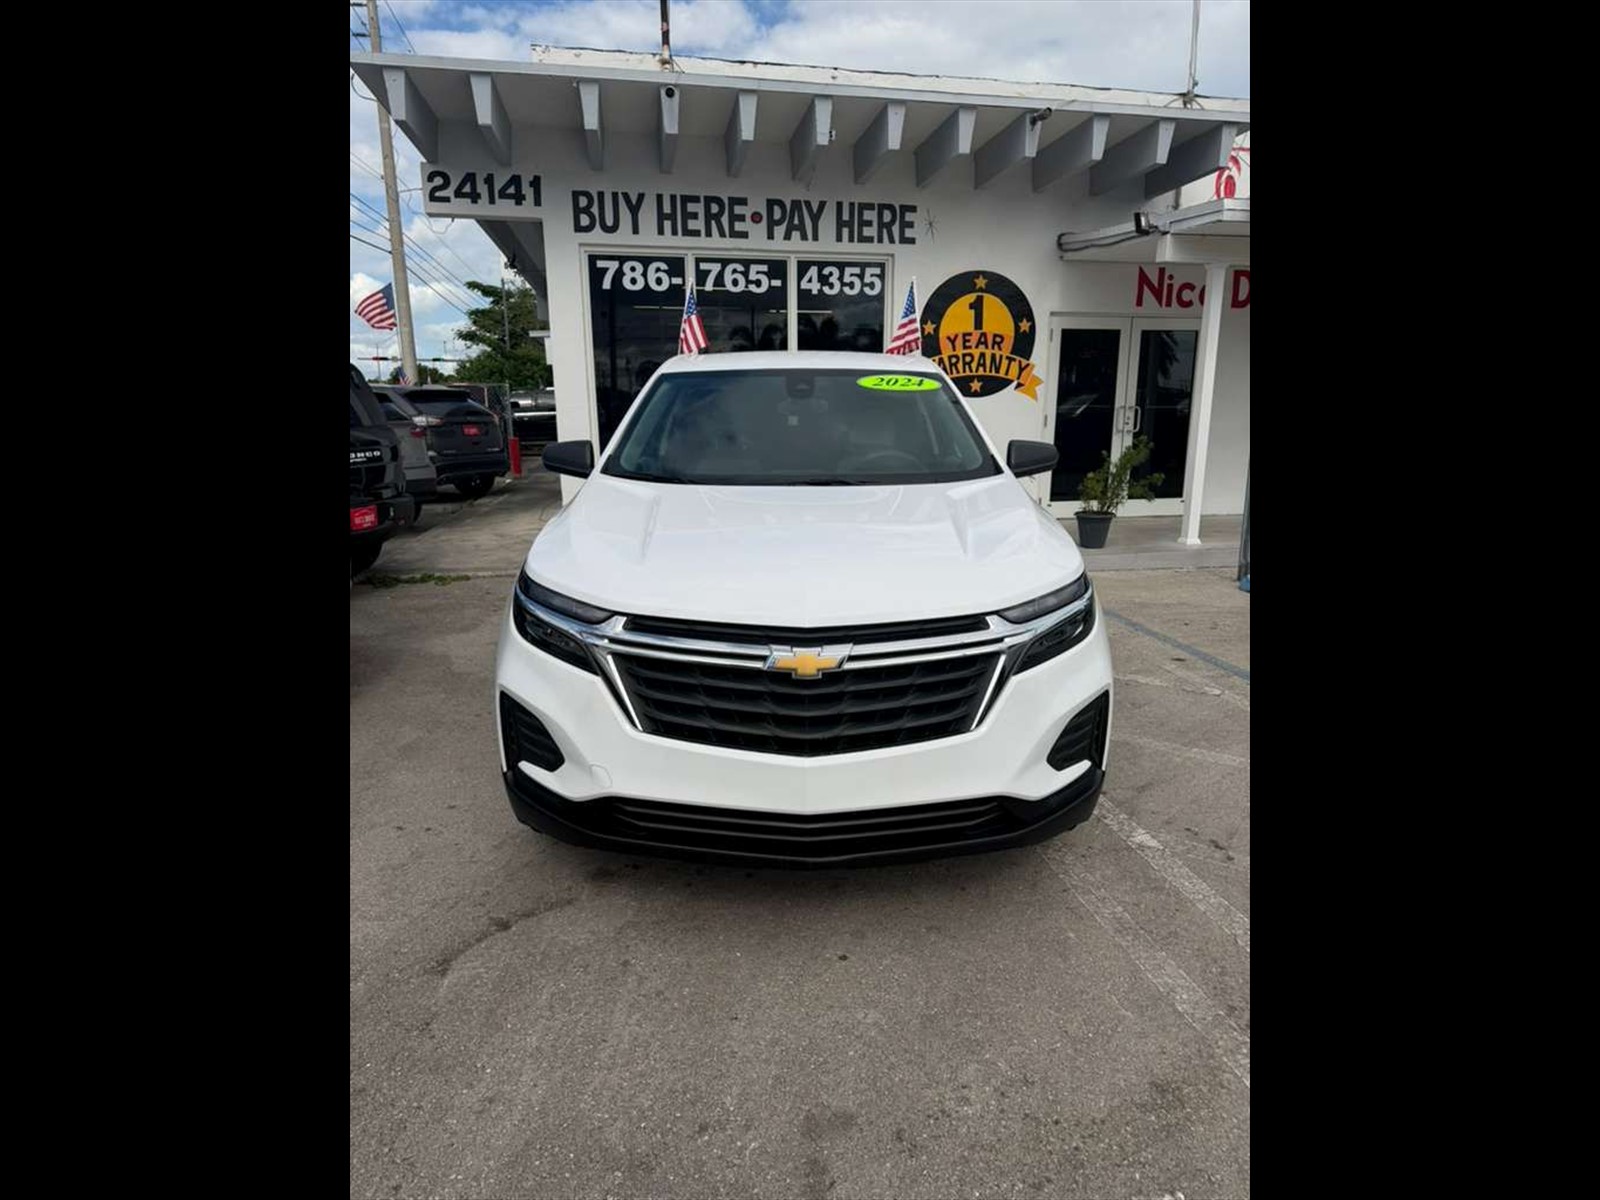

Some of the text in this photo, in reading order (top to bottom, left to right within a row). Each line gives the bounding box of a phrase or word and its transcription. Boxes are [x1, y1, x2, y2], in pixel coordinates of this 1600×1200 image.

[427, 170, 542, 207] 24141
[571, 190, 917, 244] BUY HERE PAY HERE
[596, 260, 882, 296] 786- 765- 4355
[968, 294, 985, 331] 1
[946, 331, 1005, 352] YEAR
[872, 376, 924, 387] 2024
[932, 351, 1031, 381] ARRANTY
